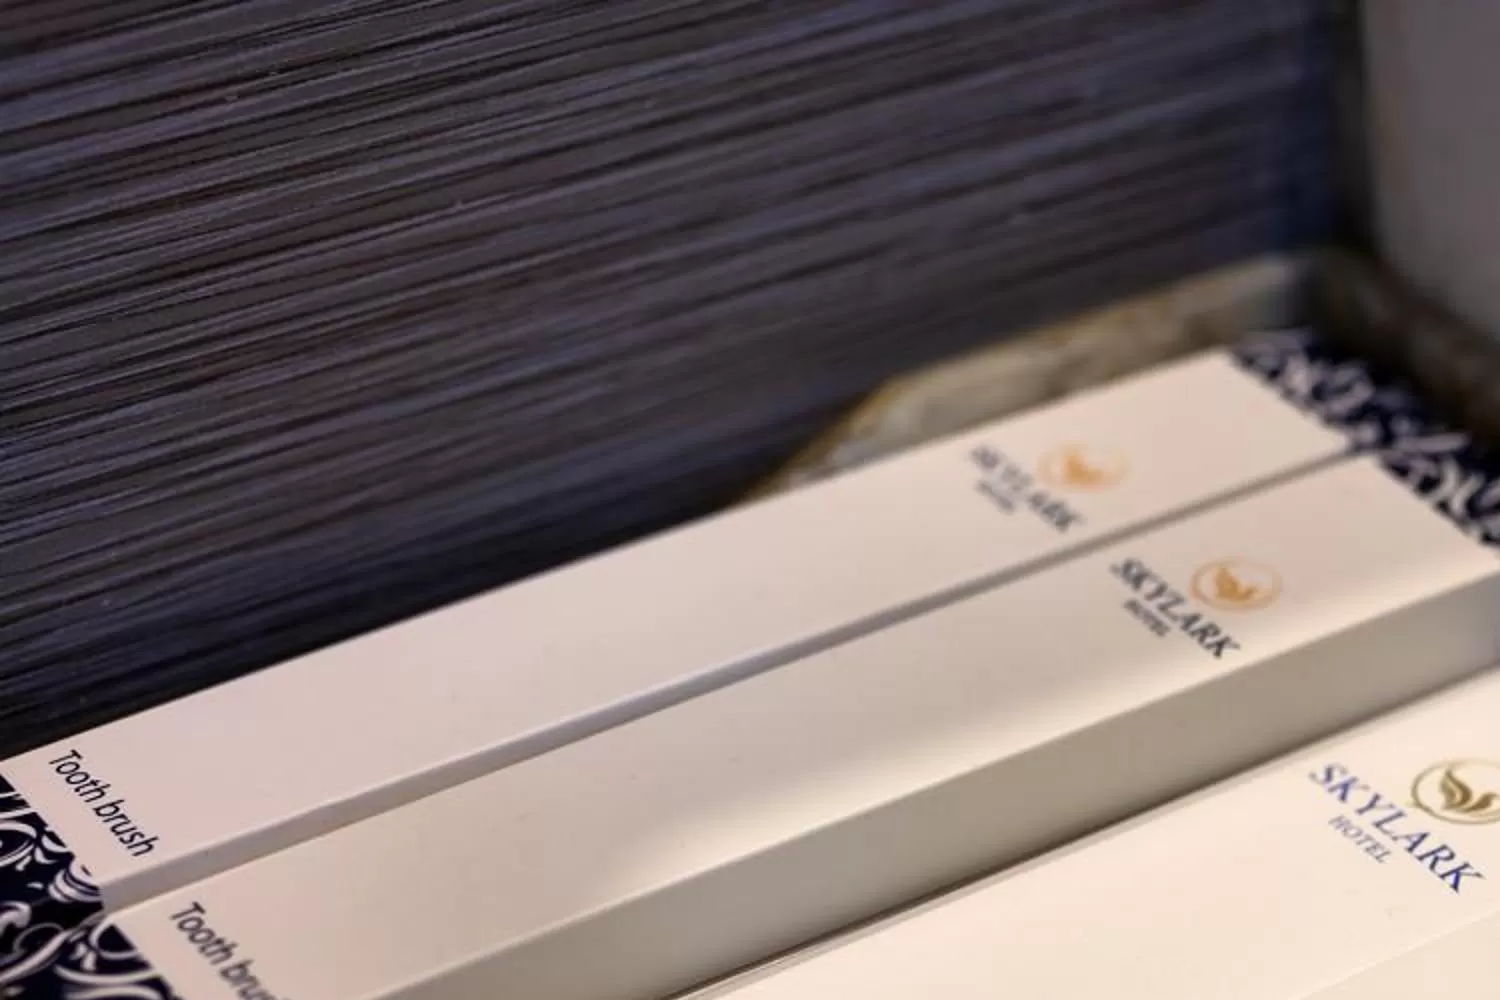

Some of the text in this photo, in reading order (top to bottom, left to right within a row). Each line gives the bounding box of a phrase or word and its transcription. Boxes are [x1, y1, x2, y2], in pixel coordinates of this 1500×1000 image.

[1110, 557, 1241, 658] SKYLARK
[48, 749, 159, 857] Tooth brush
[1309, 762, 1486, 893] SKYLARK
[1328, 814, 1392, 865] HOTEL
[169, 901, 239, 966] Tooth
